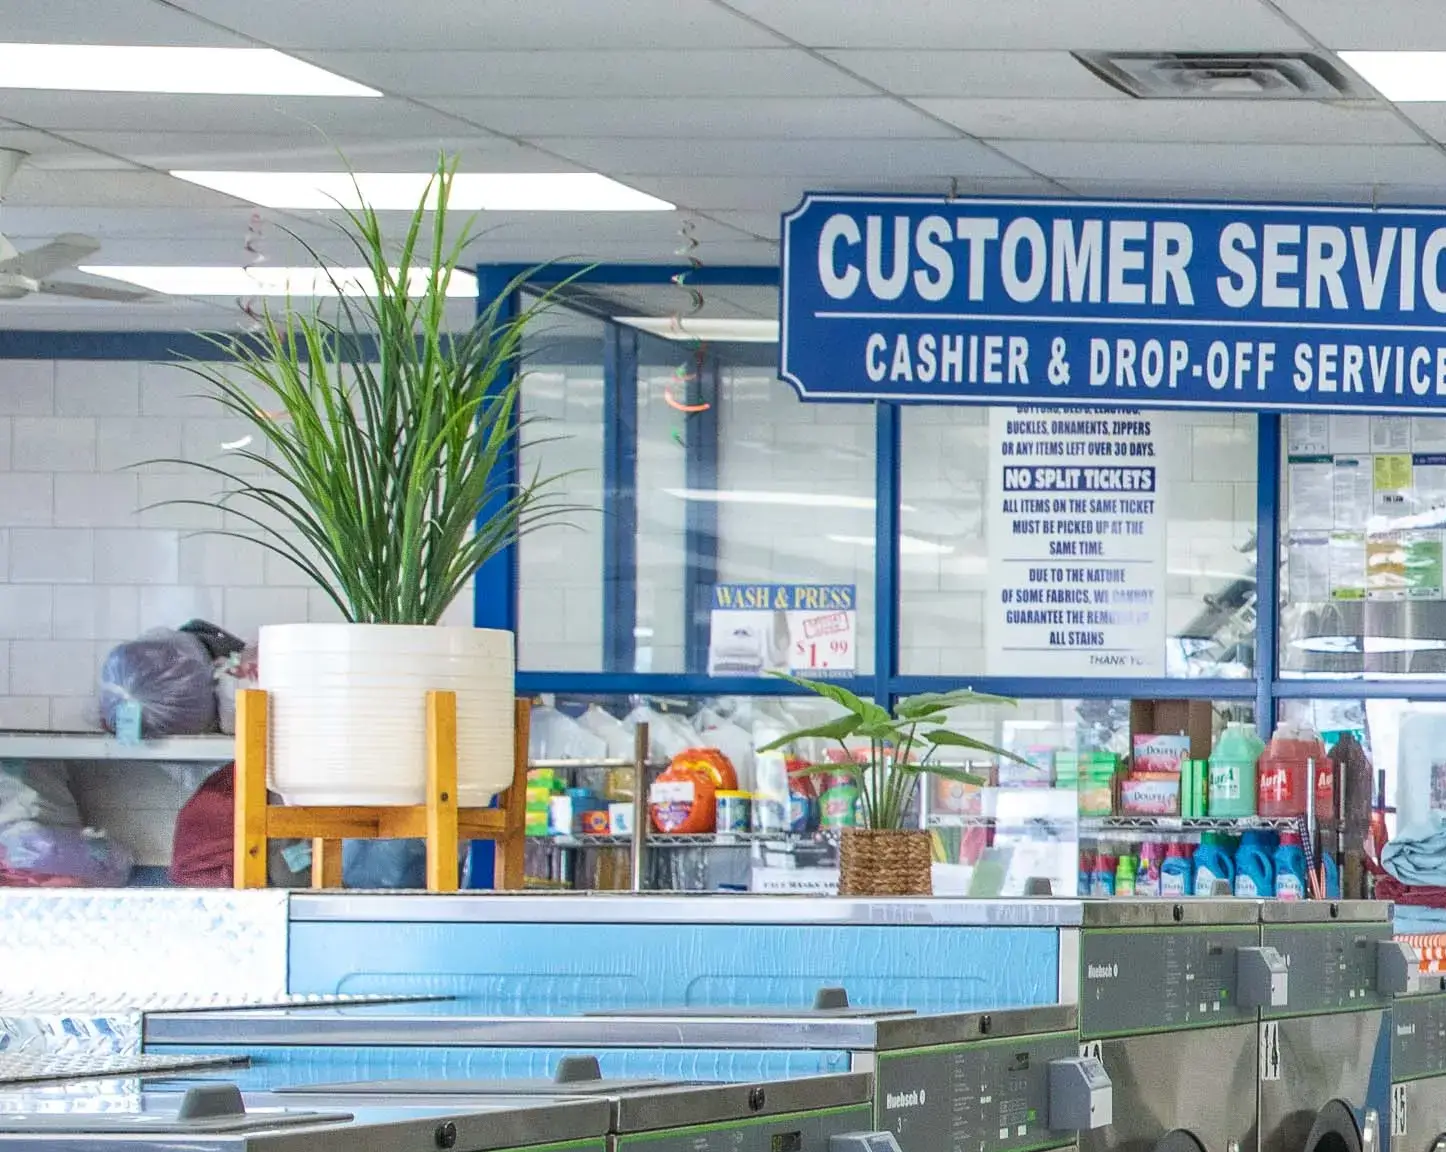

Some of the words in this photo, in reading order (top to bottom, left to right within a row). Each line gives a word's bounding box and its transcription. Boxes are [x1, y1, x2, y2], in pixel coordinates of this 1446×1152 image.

[817, 212, 1195, 307] CUSTOMER
[865, 333, 1029, 385] CASHIER
[1047, 337, 1070, 386] &
[1090, 338, 1276, 390] DROP-OFF
[1112, 420, 1151, 435] ZIPPERS
[1002, 442, 1013, 457] OR
[1016, 442, 1034, 457] ANY
[1036, 442, 1064, 457] ITEMS
[1066, 442, 1085, 457] LEFT
[1088, 442, 1112, 457] OVER
[1115, 442, 1127, 457] 30
[1005, 468, 1032, 490] NO
[1035, 468, 1081, 490] SPLIT
[1084, 468, 1152, 490] TICKETS
[1003, 499, 1018, 514] ALL
[1021, 499, 1050, 514] ITEMS
[1053, 499, 1066, 514] ON
[1069, 499, 1087, 514] THE
[1089, 499, 1117, 514] SAME
[1120, 499, 1154, 514] TICKET
[1012, 520, 1041, 534] MUST
[1043, 520, 1055, 534] BE
[1057, 520, 1093, 534] PICKED
[1096, 520, 1109, 534] UP
[1111, 520, 1123, 534] AT
[1125, 520, 1144, 534] THE
[1050, 541, 1076, 556] SAME
[1029, 568, 1049, 583] DUE
[1051, 568, 1063, 583] TO
[1066, 568, 1084, 583] THE
[1087, 568, 1125, 583] NATURE
[716, 587, 769, 609] WASH
[774, 587, 788, 609] &
[795, 587, 852, 609] PRESS
[1002, 589, 1014, 604] OF
[1016, 589, 1044, 604] SOME
[1046, 589, 1092, 604] FABRICS,
[1006, 611, 1064, 625] GUARANTEE
[1066, 611, 1084, 625] THE
[1050, 631, 1065, 645] ALL
[1068, 631, 1104, 645] STAINS
[1090, 655, 1126, 665] THANK
[1088, 963, 1113, 979] Huebsch
[1263, 1024, 1279, 1078] 14
[887, 1091, 918, 1109] Huebsch
[1393, 1086, 1406, 1135] 15
